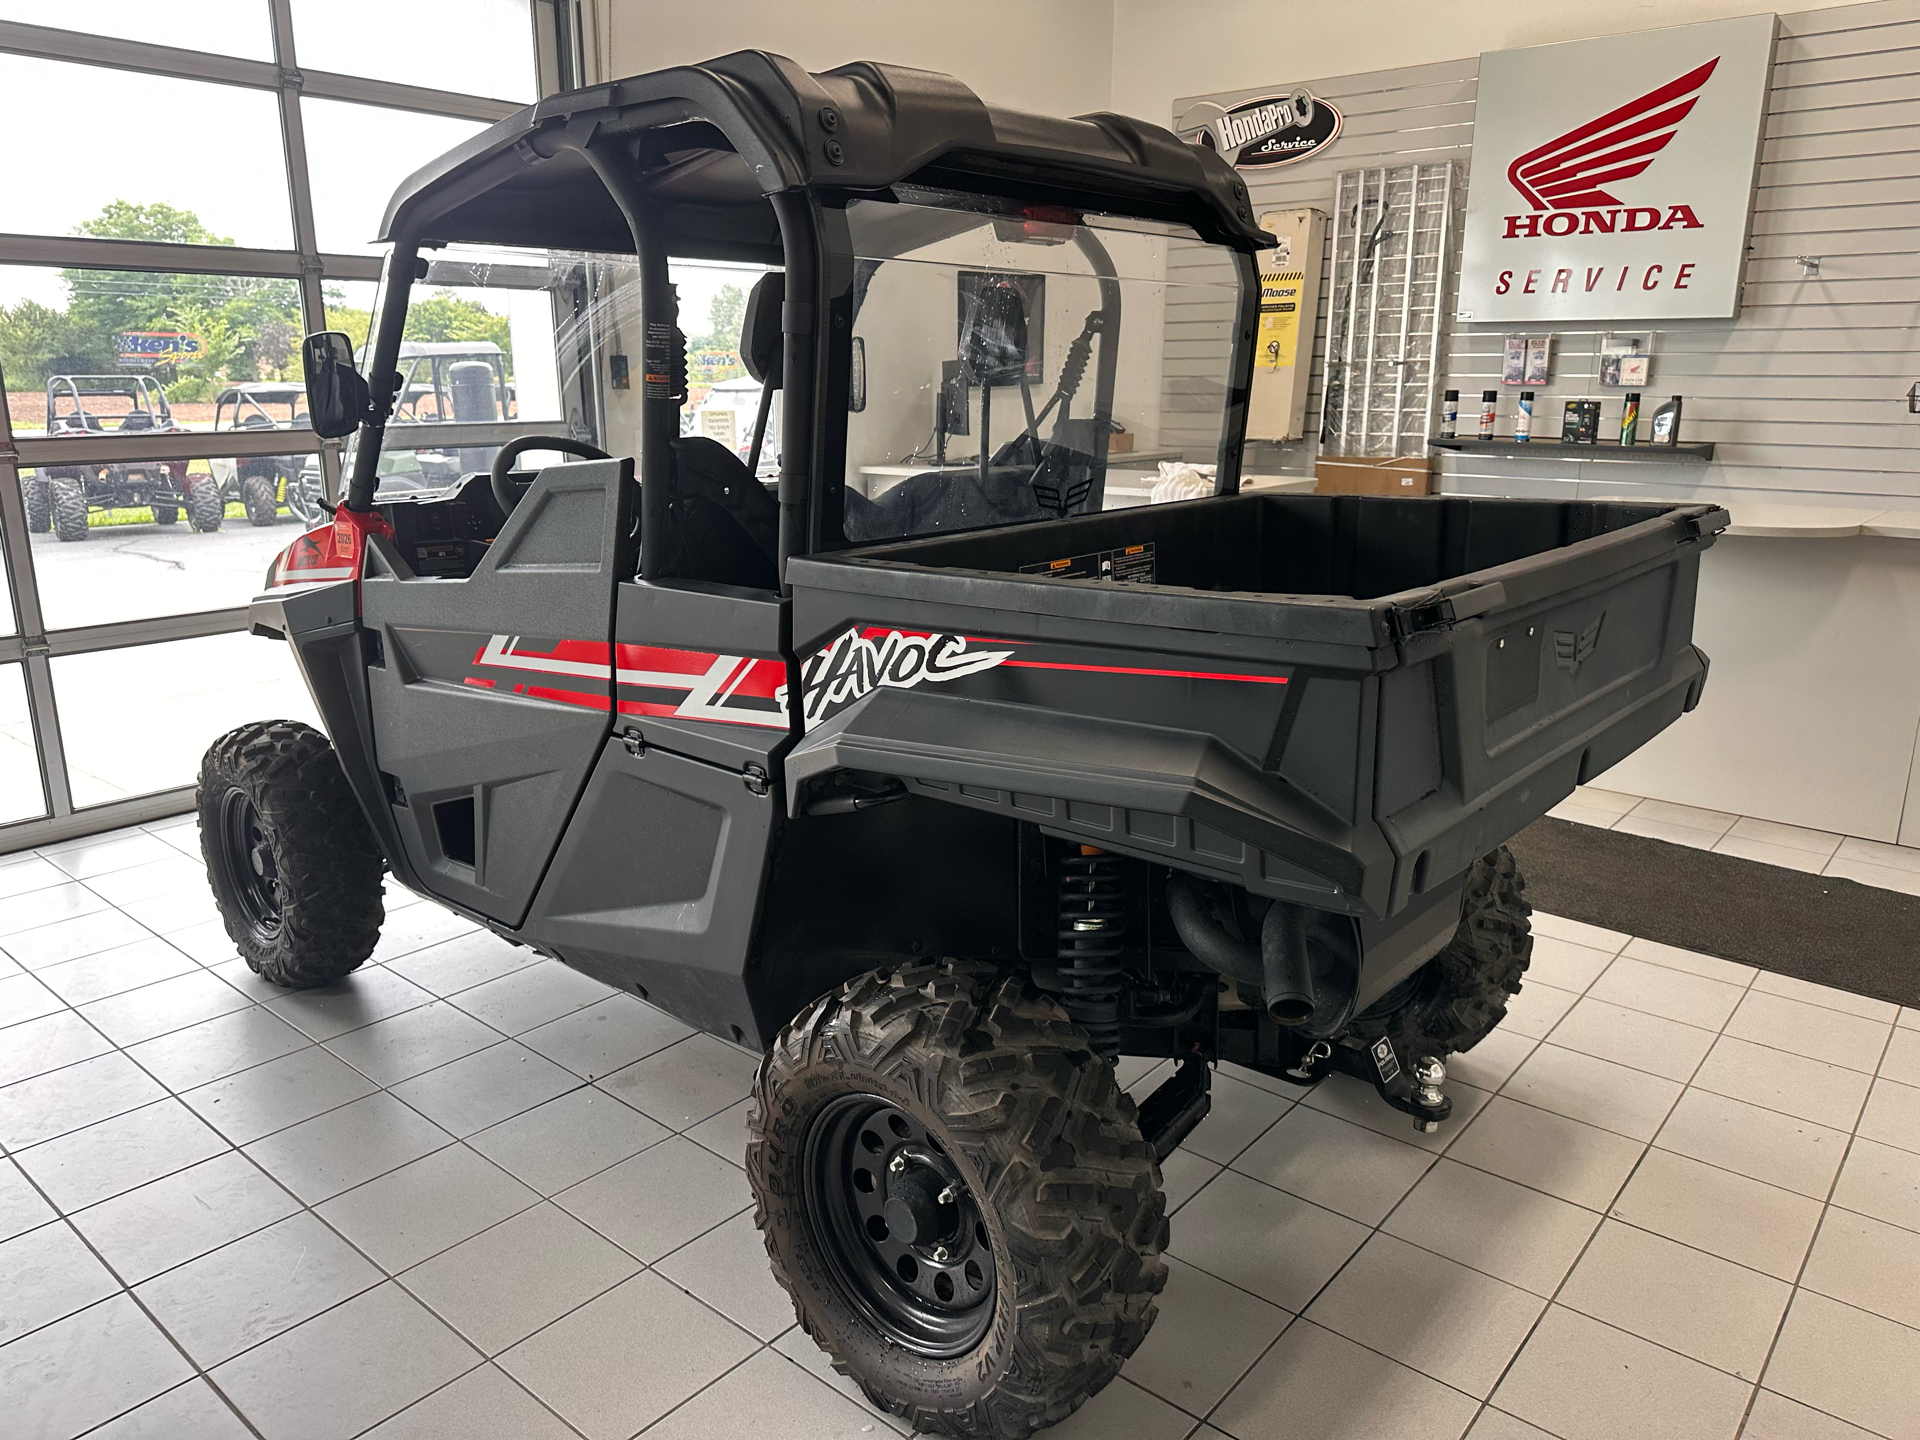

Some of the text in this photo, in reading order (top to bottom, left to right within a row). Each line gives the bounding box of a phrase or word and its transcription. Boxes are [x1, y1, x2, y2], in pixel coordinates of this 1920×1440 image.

[1215, 104, 1293, 151] HondaPro
[1260, 136, 1317, 152] Service
[1502, 205, 1704, 239] HONDA
[1262, 288, 1297, 298] Moose
[1495, 263, 1696, 295] SERVICE
[155, 347, 203, 366] Sports
[337, 533, 352, 544] 2026
[776, 629, 1013, 733] HAVOC
[769, 1096, 797, 1198] DURO
